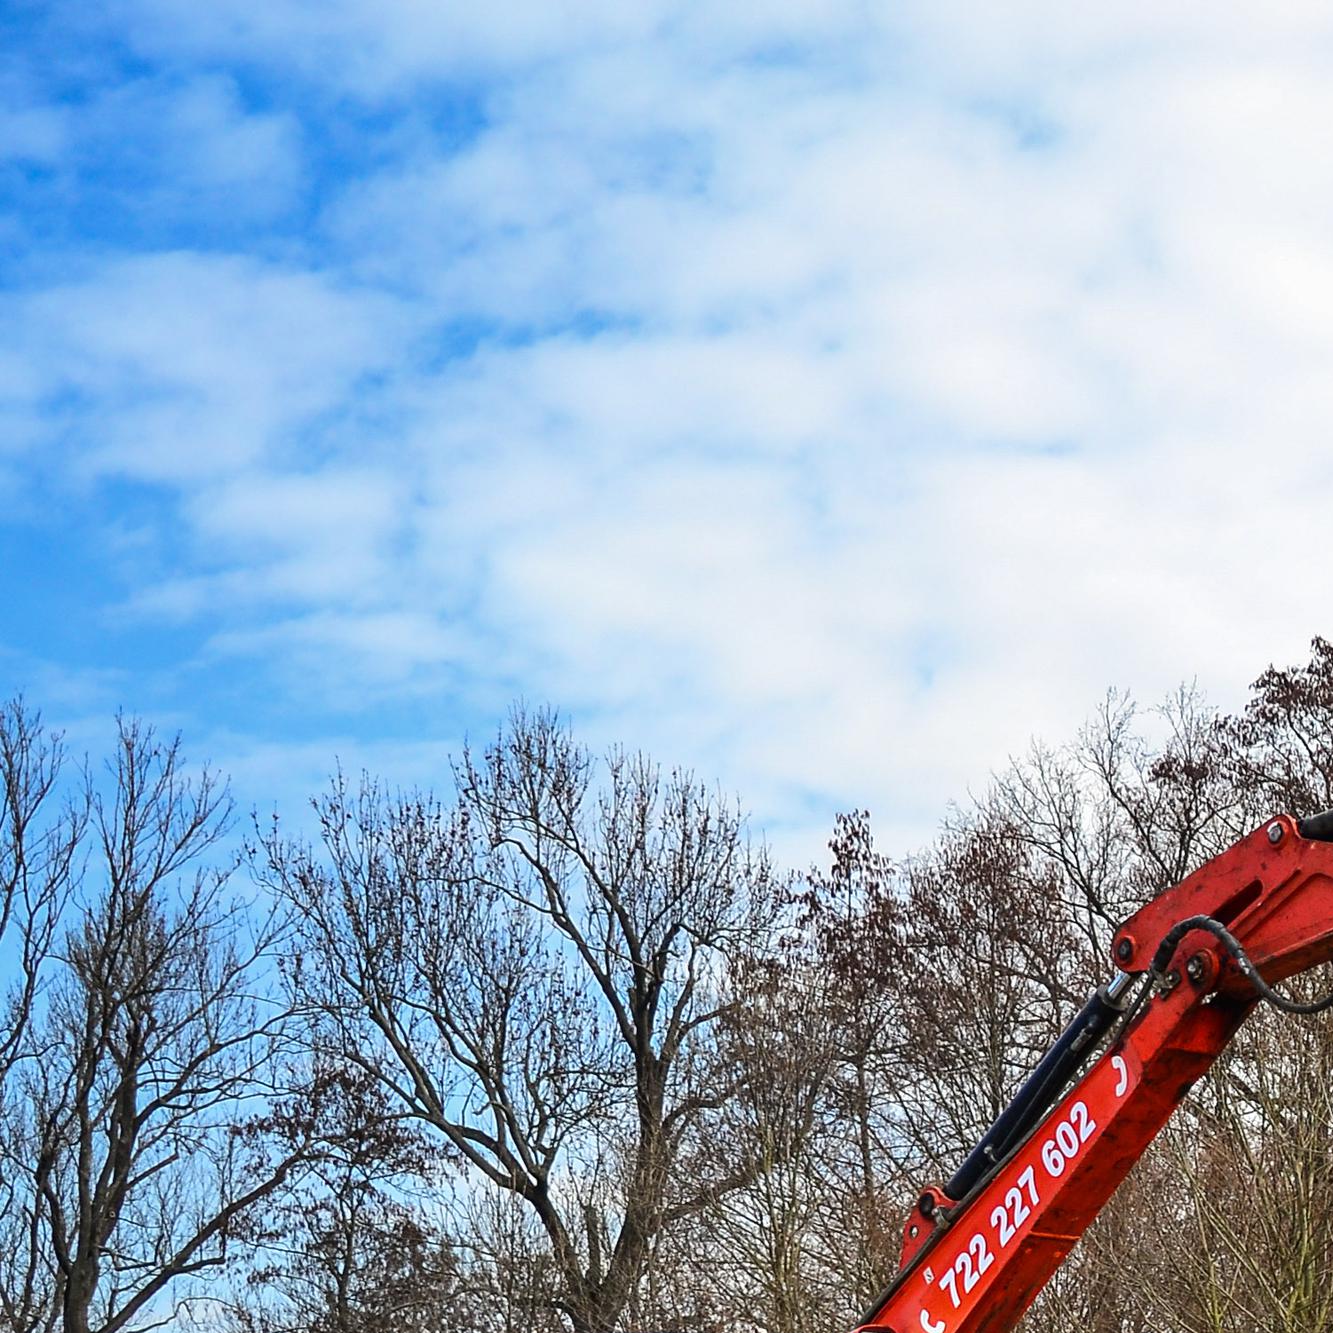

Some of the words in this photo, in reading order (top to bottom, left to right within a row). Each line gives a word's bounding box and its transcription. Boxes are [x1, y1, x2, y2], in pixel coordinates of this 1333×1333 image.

[938, 1233, 995, 1308] 722
[990, 1165, 1041, 1249] 227
[1040, 1100, 1097, 1178] 602
